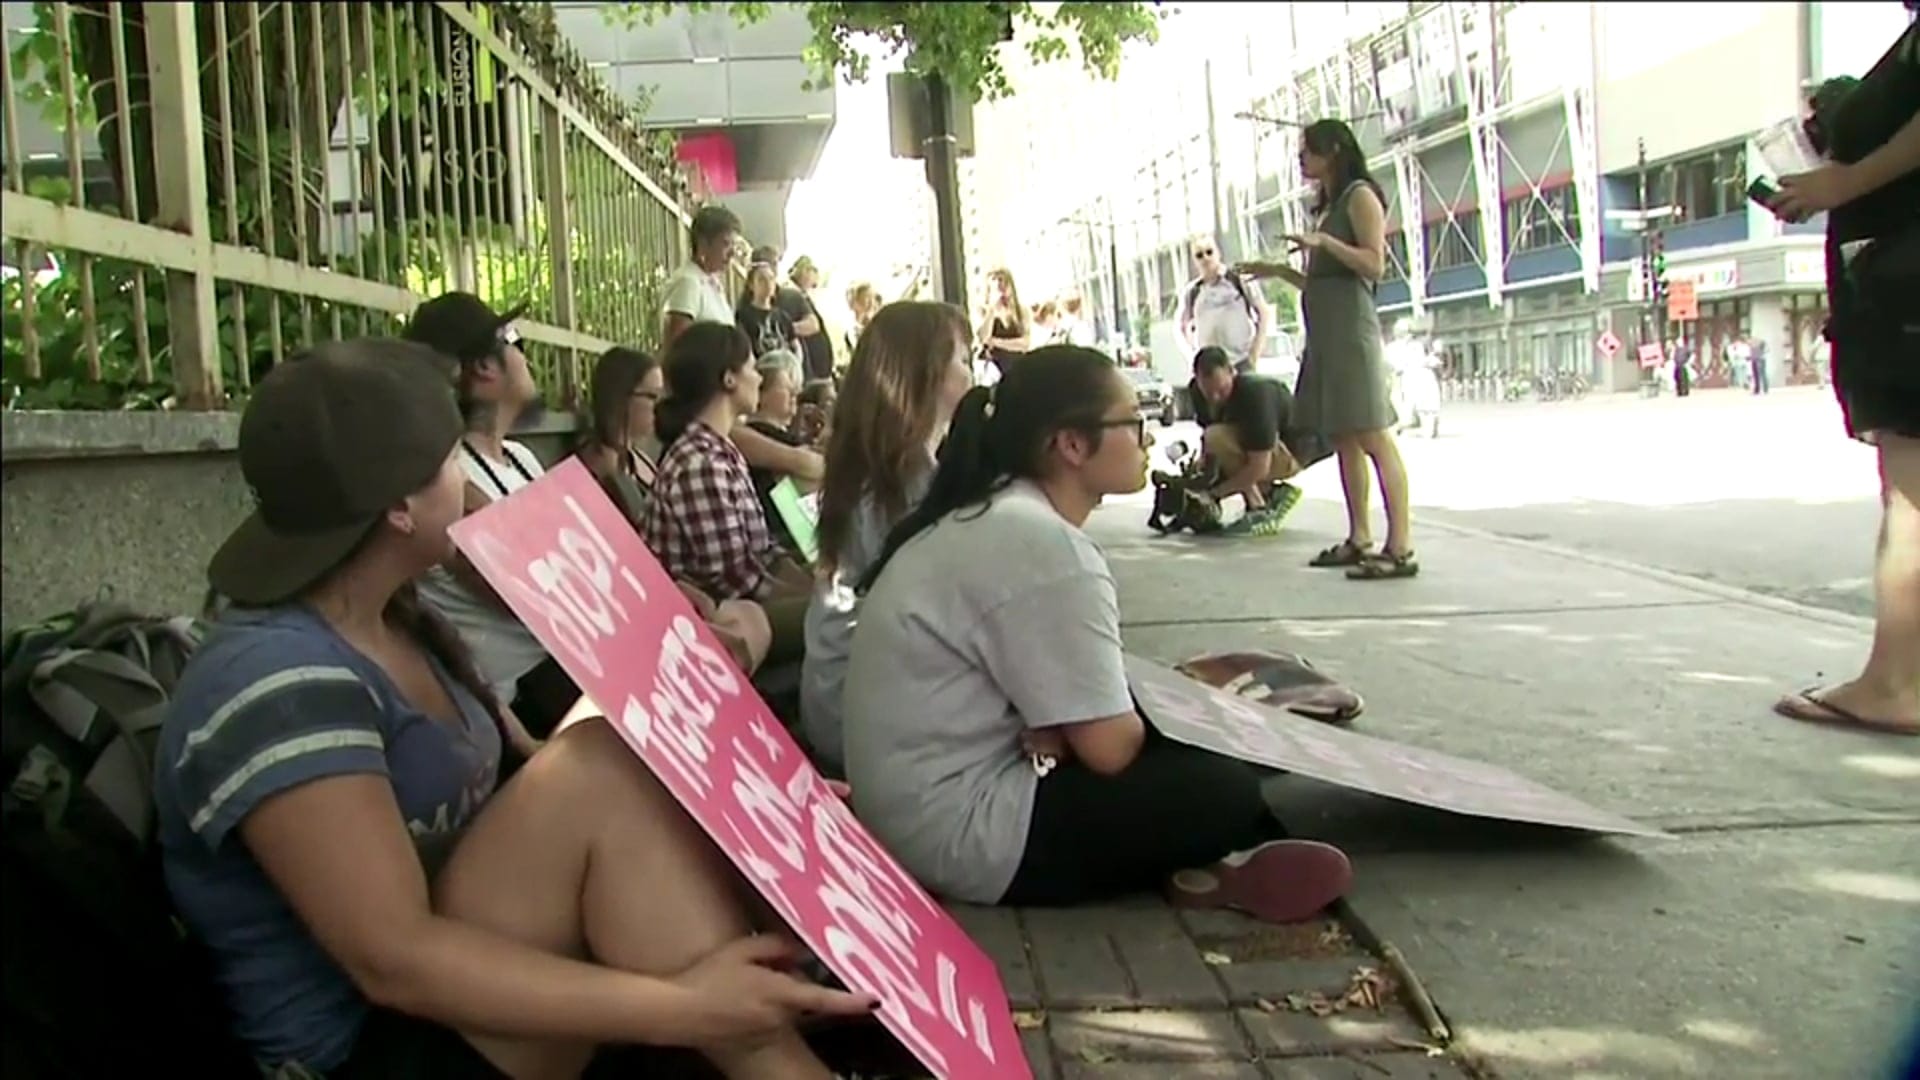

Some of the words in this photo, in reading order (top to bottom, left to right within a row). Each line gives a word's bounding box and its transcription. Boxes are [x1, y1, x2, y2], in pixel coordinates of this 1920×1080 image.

[376, 146, 507, 187] MSO
[472, 495, 647, 677] STOP!
[622, 613, 741, 799] TICKETS
[731, 737, 807, 873] ON
